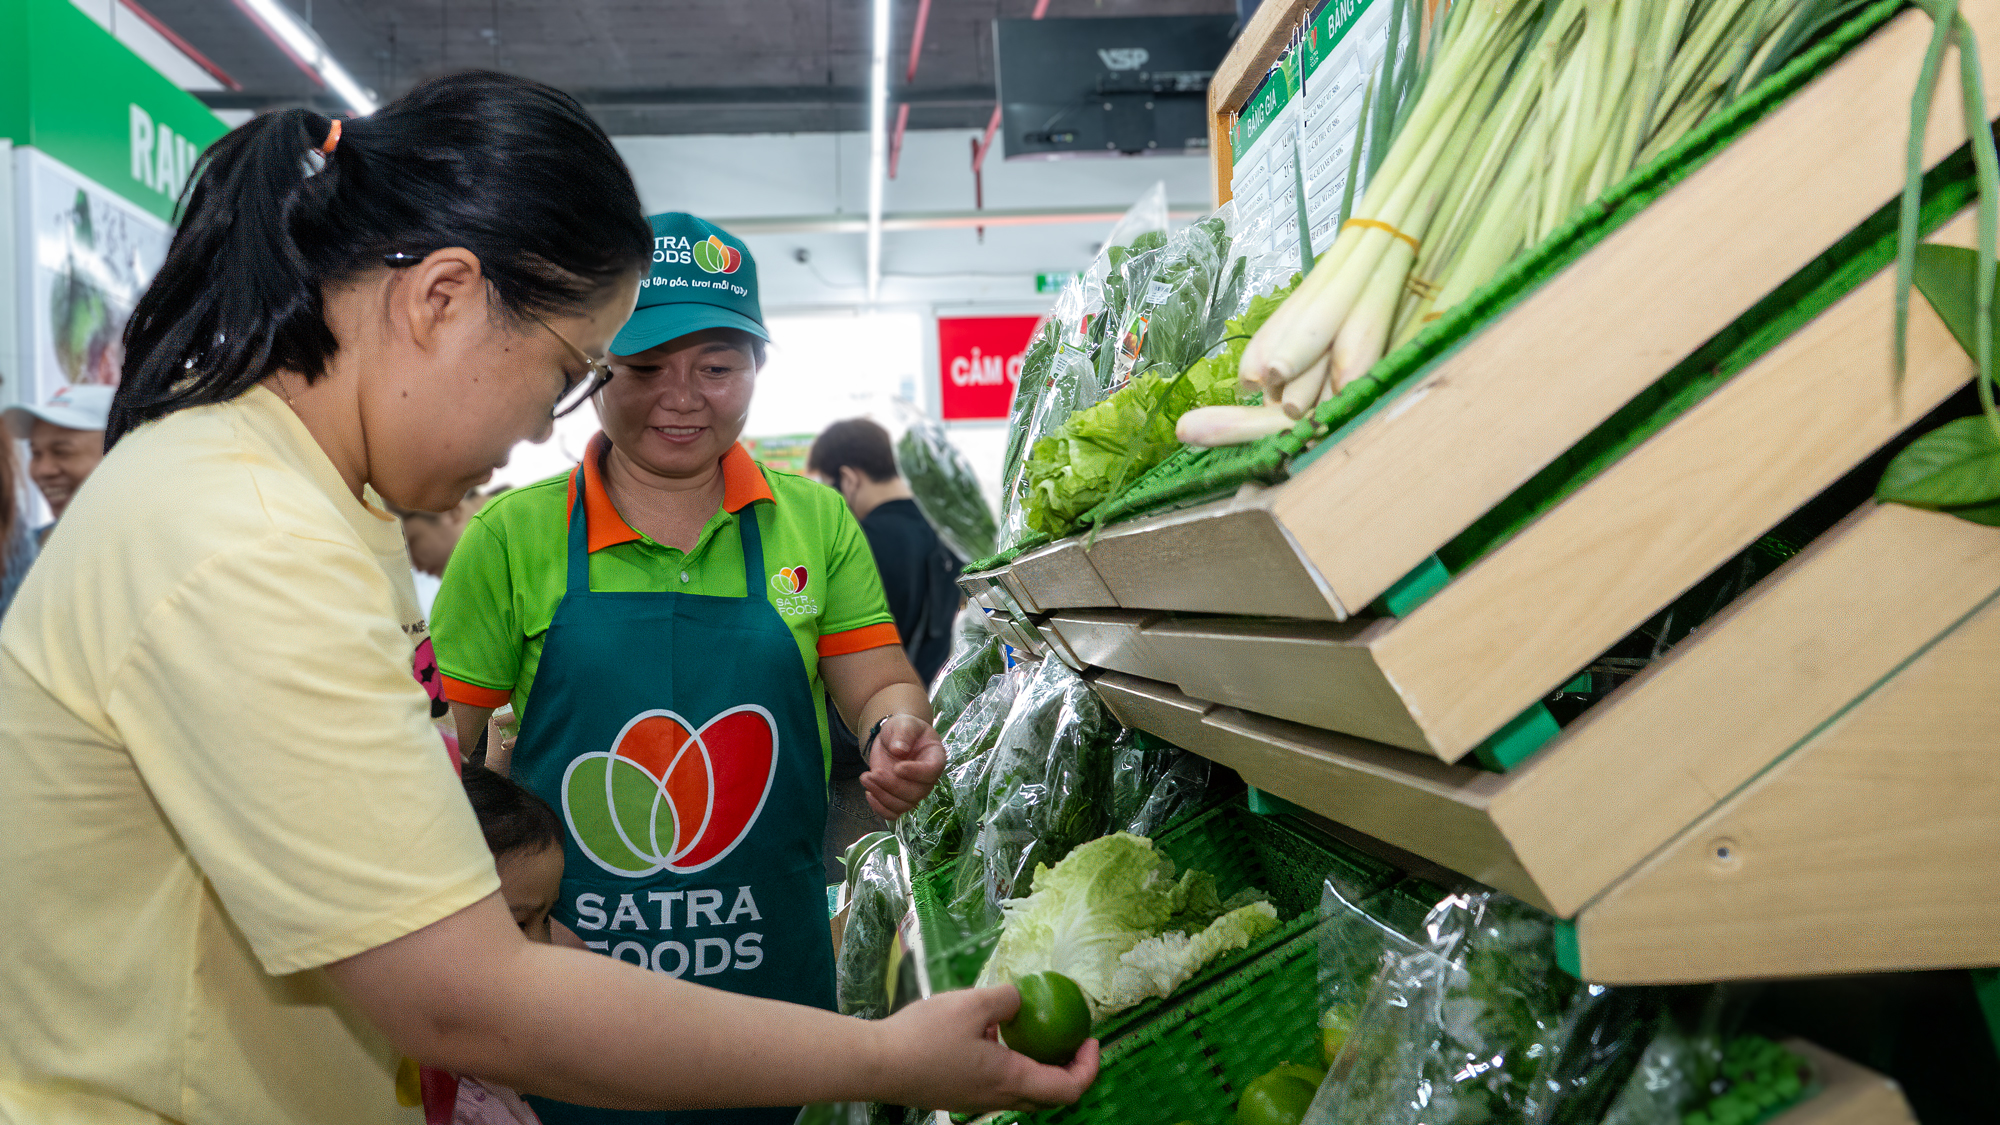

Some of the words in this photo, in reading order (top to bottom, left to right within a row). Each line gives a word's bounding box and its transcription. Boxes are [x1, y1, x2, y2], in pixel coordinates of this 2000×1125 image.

[1247, 102, 1264, 138] BẢNG
[1265, 81, 1277, 116] GIÁ
[652, 249, 692, 264] ODS
[654, 236, 691, 250] TRA
[950, 345, 1004, 387] CẢM
[778, 604, 818, 616] FOODS
[575, 885, 763, 931] SATRA
[584, 931, 764, 980] OODS
